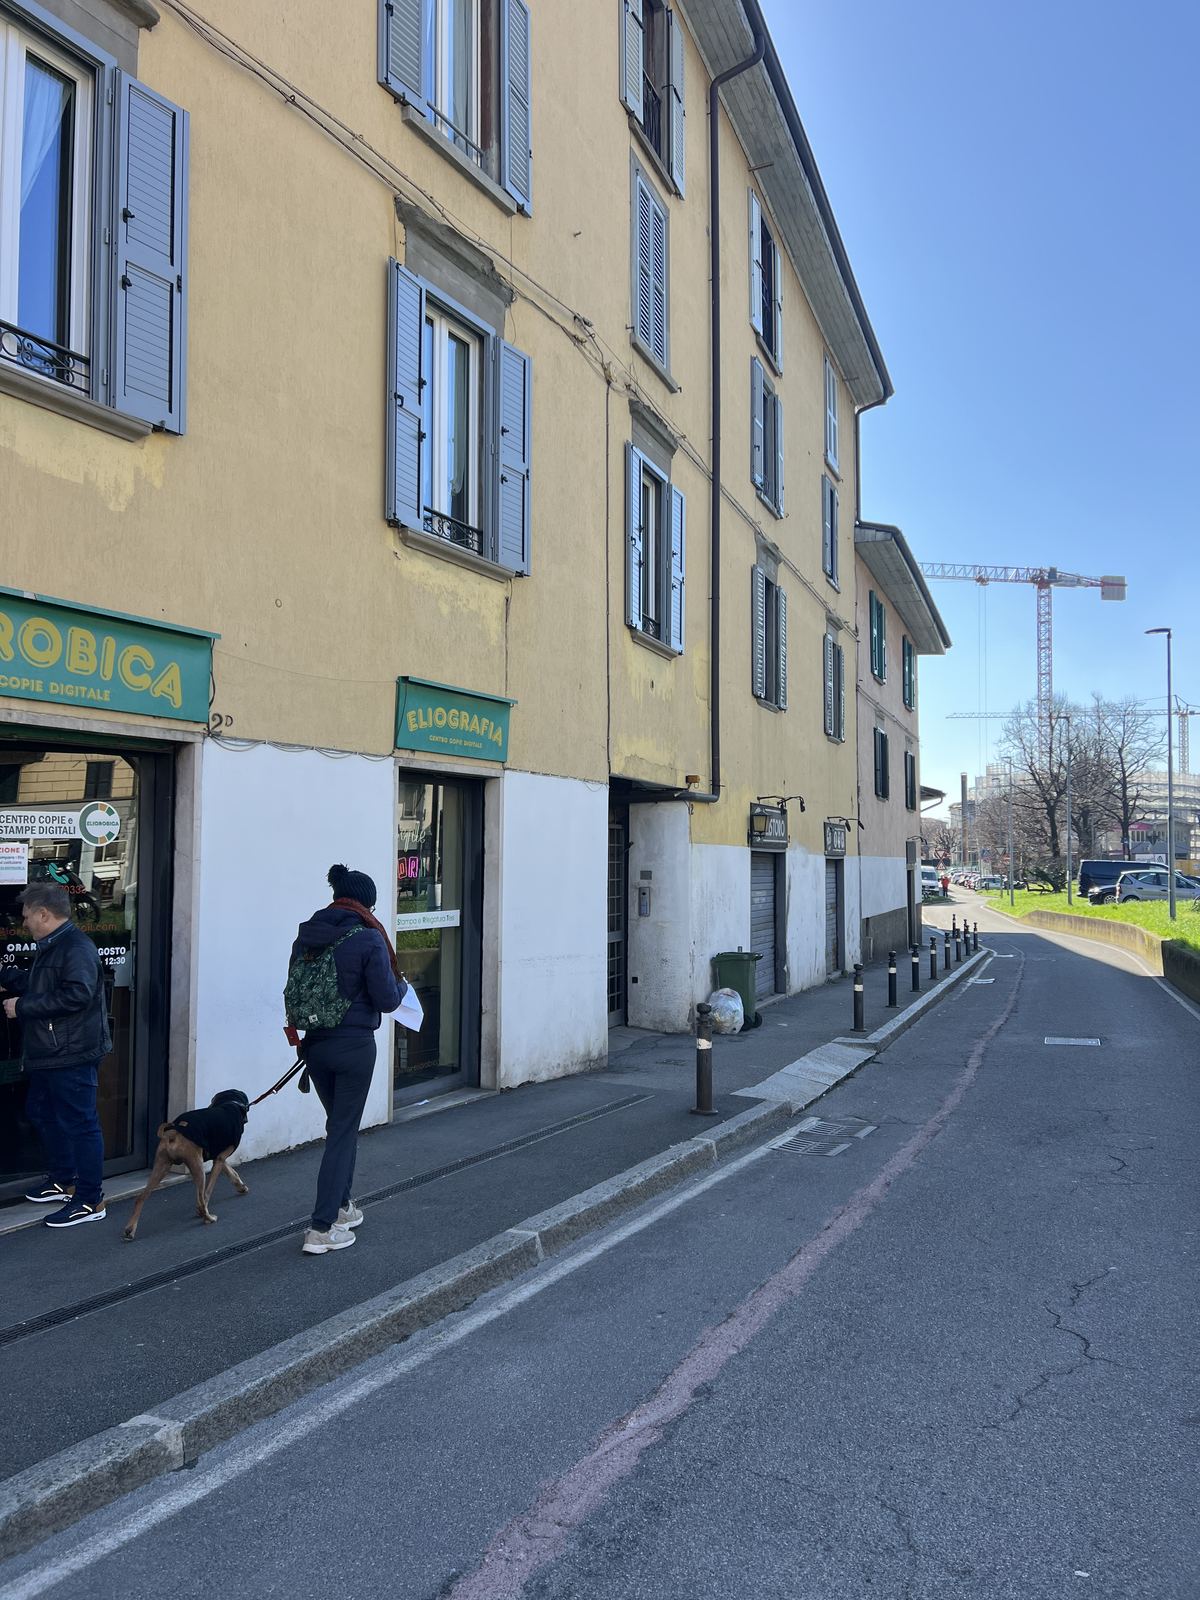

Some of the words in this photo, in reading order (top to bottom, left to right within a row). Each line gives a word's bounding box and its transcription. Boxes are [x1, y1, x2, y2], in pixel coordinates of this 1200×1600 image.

[49, 681, 111, 701] DIGITALE
[406, 707, 503, 747] ELIOGRAFIA
[0, 815, 36, 824] CENTRO
[38, 815, 66, 824] COPIE
[0, 825, 37, 835] STAMPE
[38, 825, 76, 835] DIGITALI
[397, 917, 417, 926] Stampa
